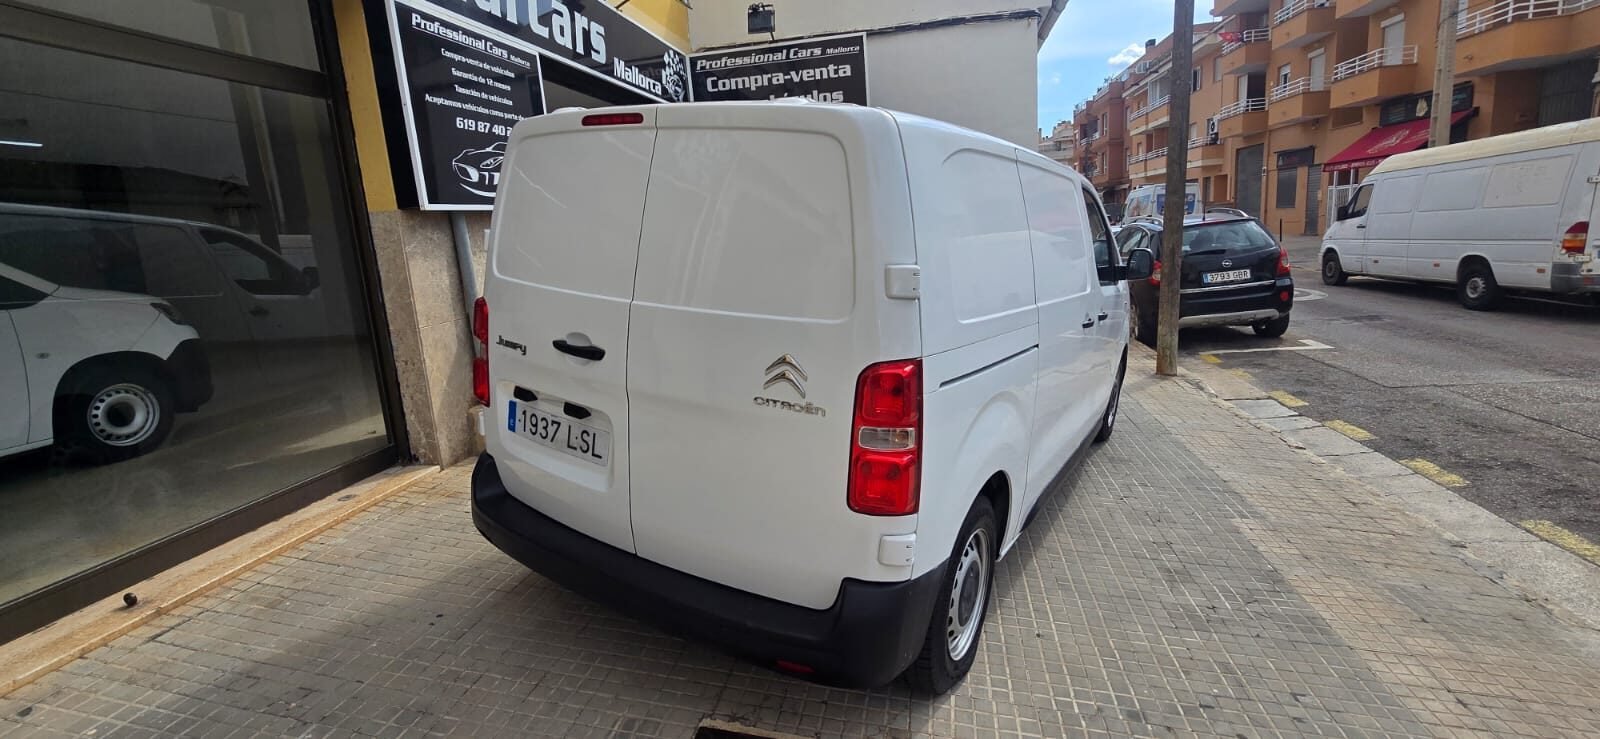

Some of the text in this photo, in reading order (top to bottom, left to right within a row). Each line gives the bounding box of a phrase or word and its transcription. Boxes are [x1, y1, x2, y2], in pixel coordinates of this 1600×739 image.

[411, 12, 486, 50] Professional
[486, 41, 509, 59] Cars
[696, 45, 860, 70] Professional Cars Mallorca
[486, 78, 494, 86] 12
[613, 56, 662, 96] Mallorca
[706, 63, 852, 92] Compra-venta
[425, 93, 462, 109] Aceptamos
[489, 109, 504, 118] como
[456, 117, 476, 131] 619
[477, 121, 491, 133] 87
[492, 124, 506, 136] 40
[1232, 270, 1249, 280] GBR
[496, 335, 527, 356] Jumpy
[522, 409, 603, 459] 1937 LSL
